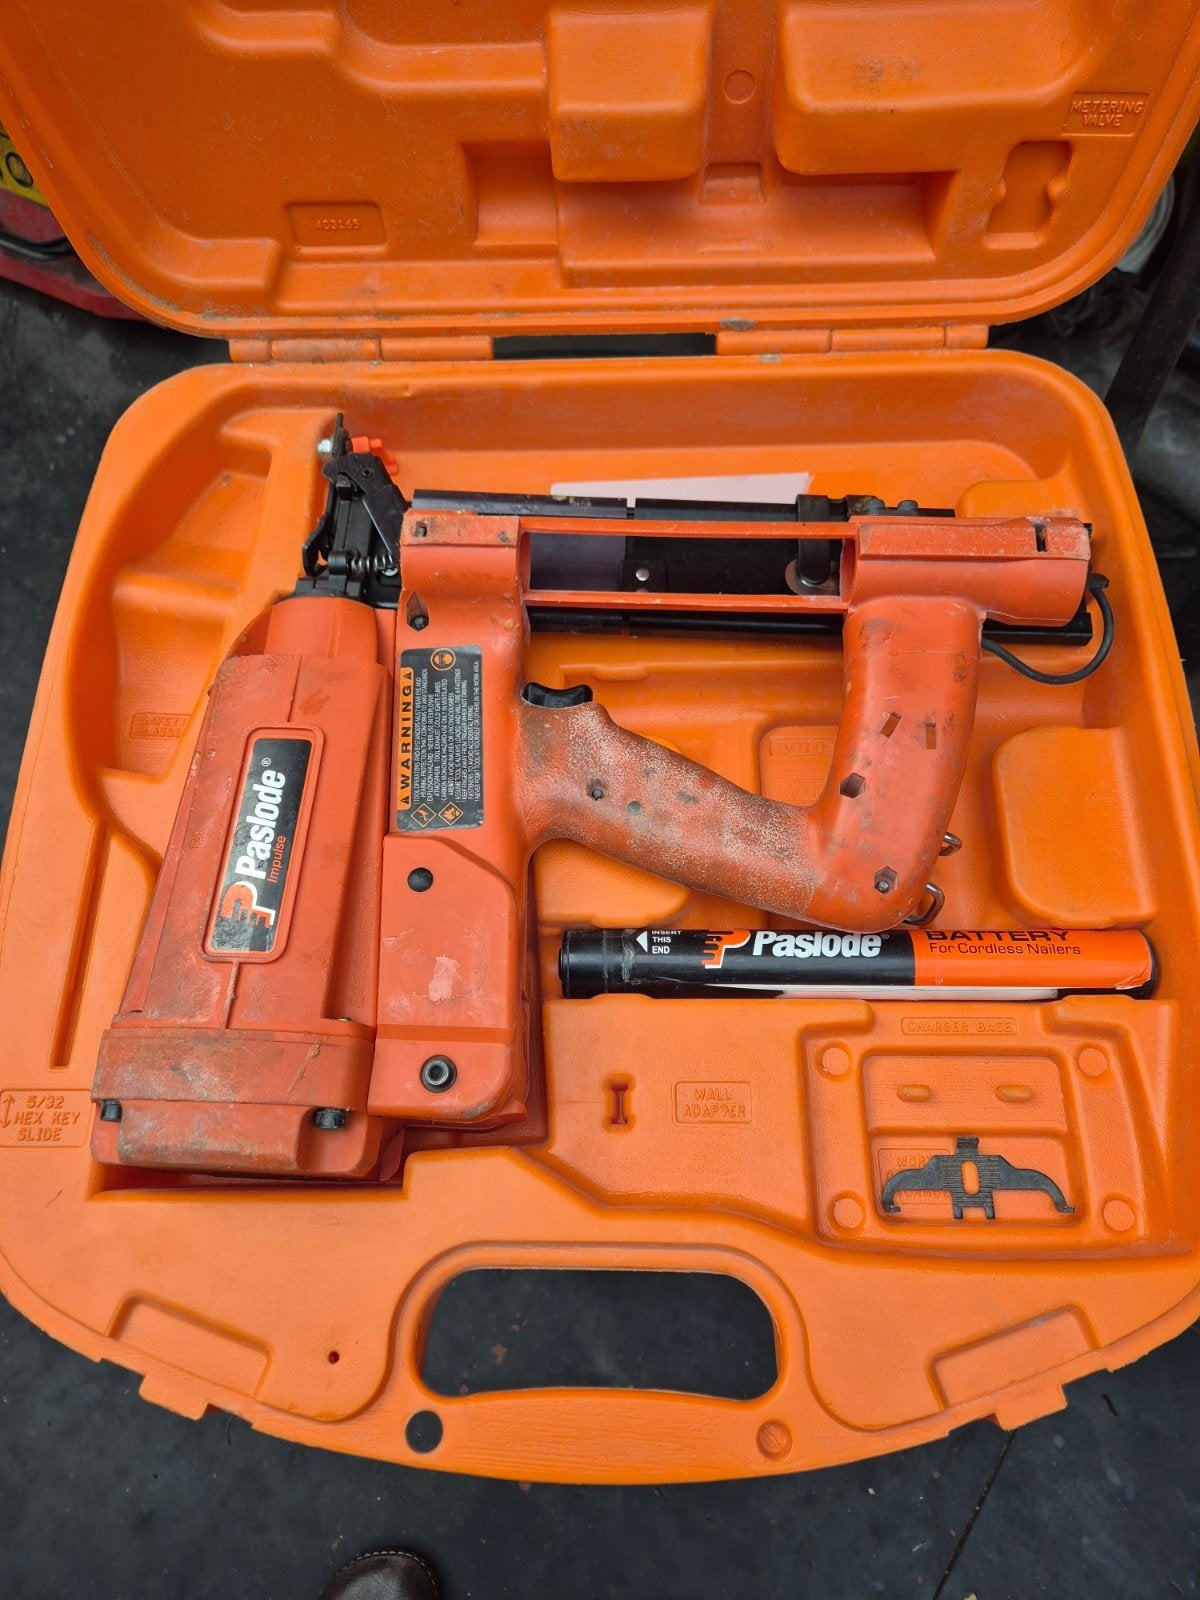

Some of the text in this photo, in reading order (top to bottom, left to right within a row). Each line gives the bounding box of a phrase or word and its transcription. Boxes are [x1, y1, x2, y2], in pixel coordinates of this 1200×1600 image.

[1070, 100, 1144, 113] METERING
[1083, 114, 1123, 127] VALVE
[401, 686, 411, 790] WARNING
[235, 769, 286, 880] Paslode
[266, 835, 286, 883] Impulse
[925, 930, 1069, 942] BATTERY
[651, 946, 670, 954] END
[753, 931, 882, 958] Paslode
[930, 943, 1081, 955] For Cordless Nailers
[907, 1022, 1012, 1033] CHARGER BASE
[694, 1088, 734, 1101] WALL
[26, 1095, 64, 1109] 5/32
[683, 1103, 745, 1118] ADAPTER
[14, 1111, 81, 1125] HEX KEY
[17, 1127, 62, 1141] SLIDE
[896, 1155, 930, 1168] WOR
